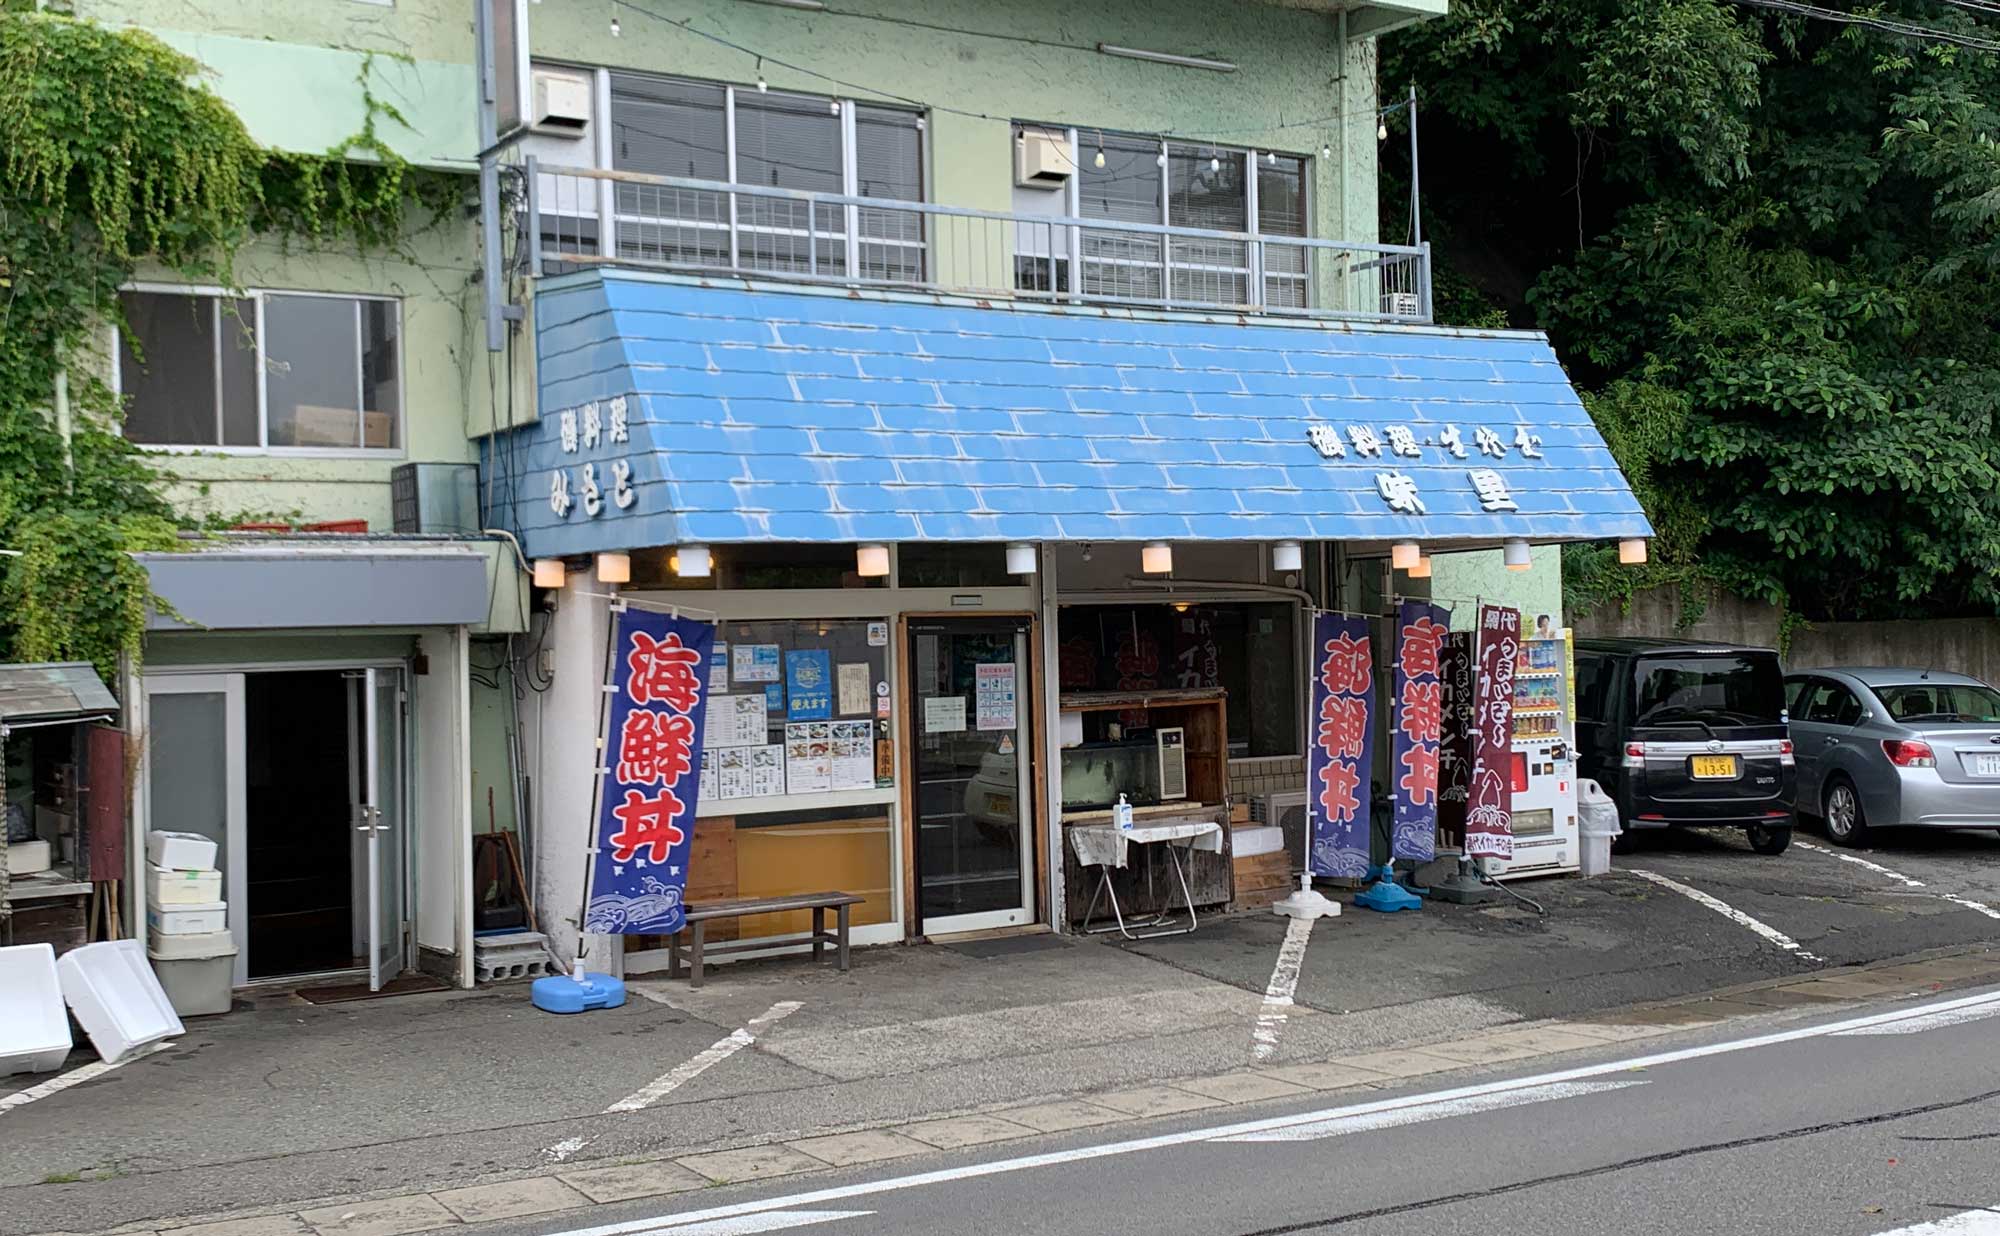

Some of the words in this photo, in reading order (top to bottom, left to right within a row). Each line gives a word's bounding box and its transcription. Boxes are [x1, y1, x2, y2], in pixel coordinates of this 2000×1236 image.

[561, 396, 628, 453] 磯料理
[551, 458, 635, 518] みさと
[1374, 468, 1519, 515] 味里
[609, 631, 702, 865] 海鮮丼
[1704, 764, 1731, 775] 13-51
